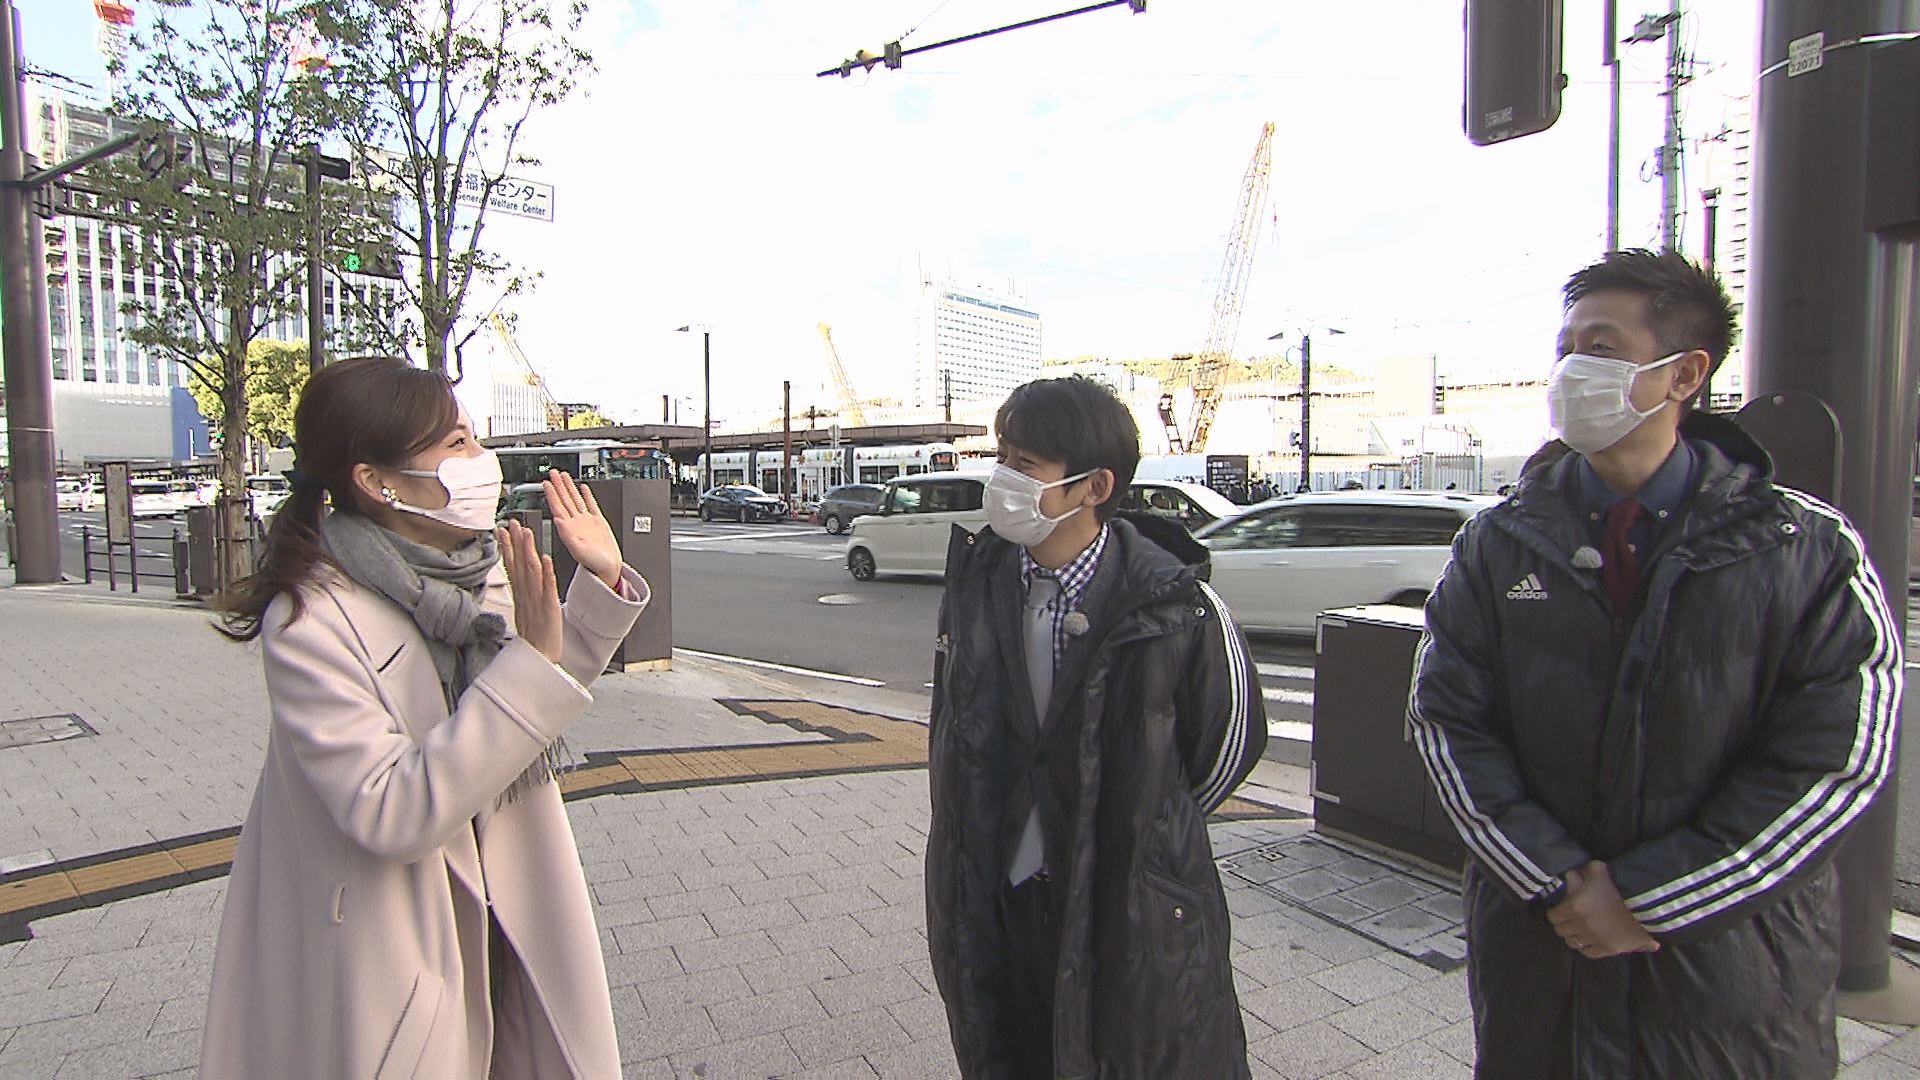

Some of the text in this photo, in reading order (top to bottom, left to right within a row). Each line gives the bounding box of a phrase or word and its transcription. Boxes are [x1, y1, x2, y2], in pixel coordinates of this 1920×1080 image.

[458, 193, 546, 216] Gener Welfare Center
[1506, 588, 1548, 600] adidas
